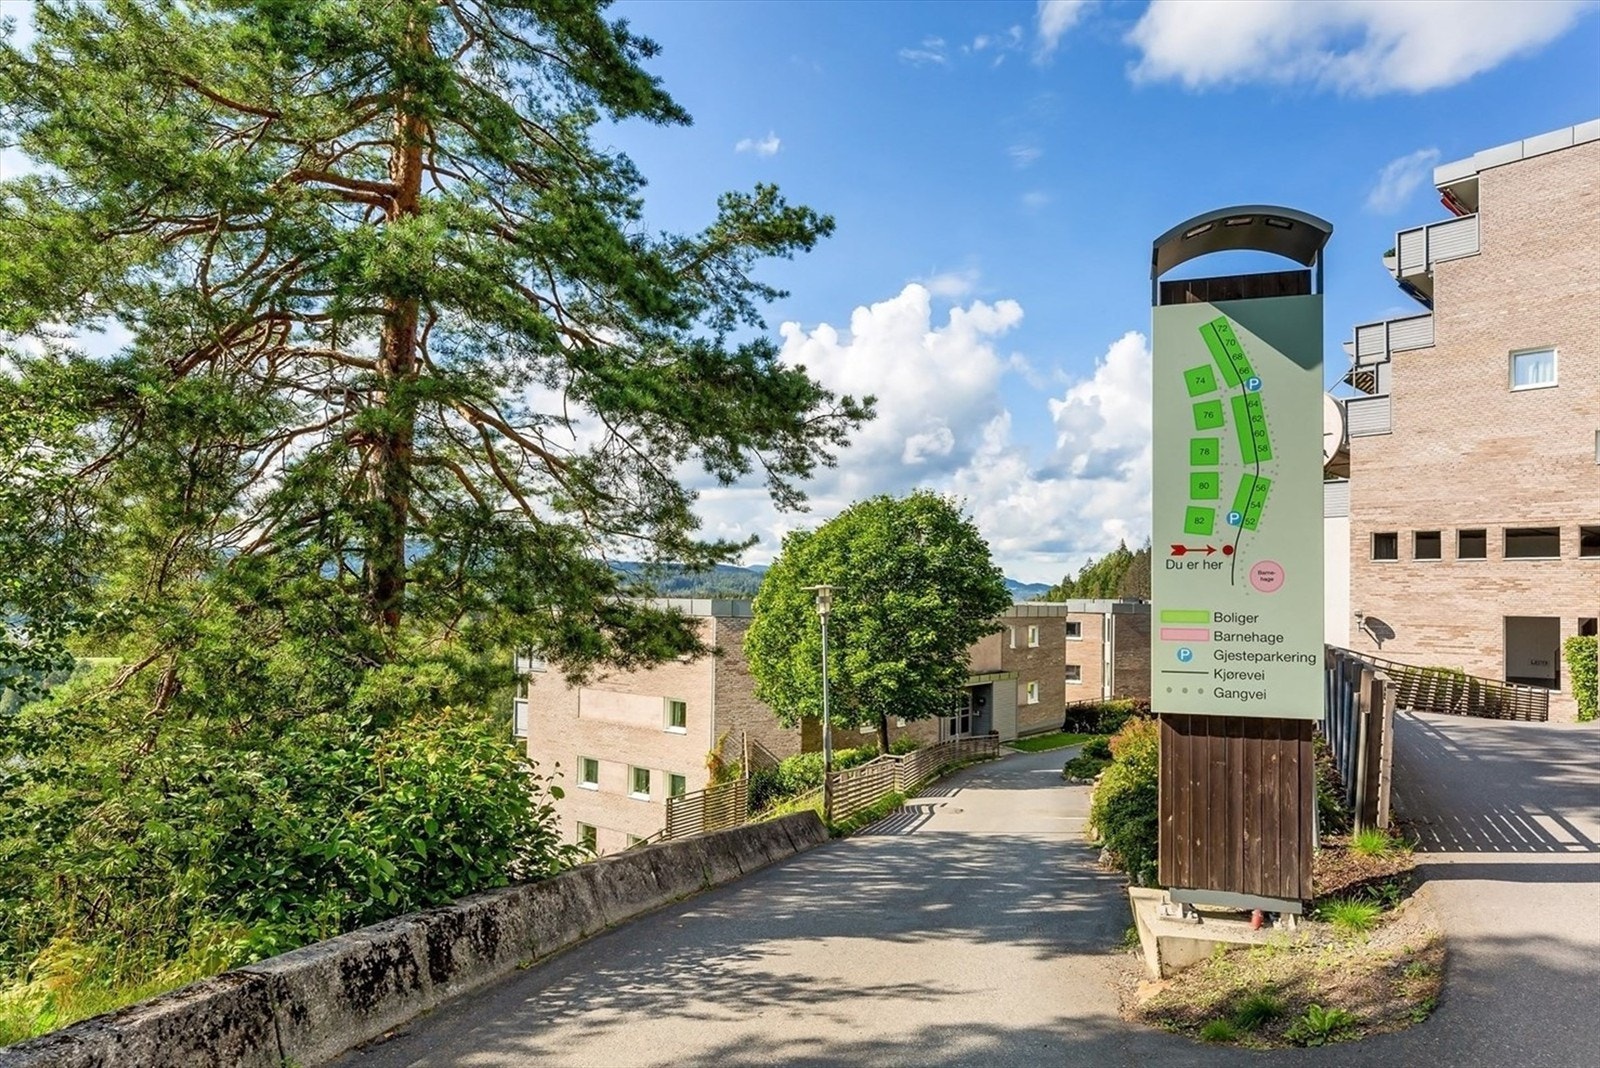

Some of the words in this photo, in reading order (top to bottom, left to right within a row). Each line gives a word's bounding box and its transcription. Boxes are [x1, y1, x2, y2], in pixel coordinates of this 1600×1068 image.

[1232, 352, 1243, 360] 68
[1239, 366, 1250, 374] 66
[1250, 378, 1259, 390] P
[1204, 411, 1214, 419] 76
[1254, 430, 1265, 438] 60
[1258, 444, 1268, 452] 58
[1230, 512, 1240, 524] P
[1244, 518, 1256, 526] 52
[1166, 559, 1185, 570] Du
[1186, 562, 1199, 570] er
[1203, 560, 1224, 570] her
[1214, 612, 1259, 626] Boliger
[1214, 631, 1284, 645] Barnehage
[1180, 649, 1190, 660] P
[1213, 650, 1317, 666] Gjesteparkering
[1214, 668, 1266, 682] Kjørevei
[1213, 687, 1267, 702] Gangvei
